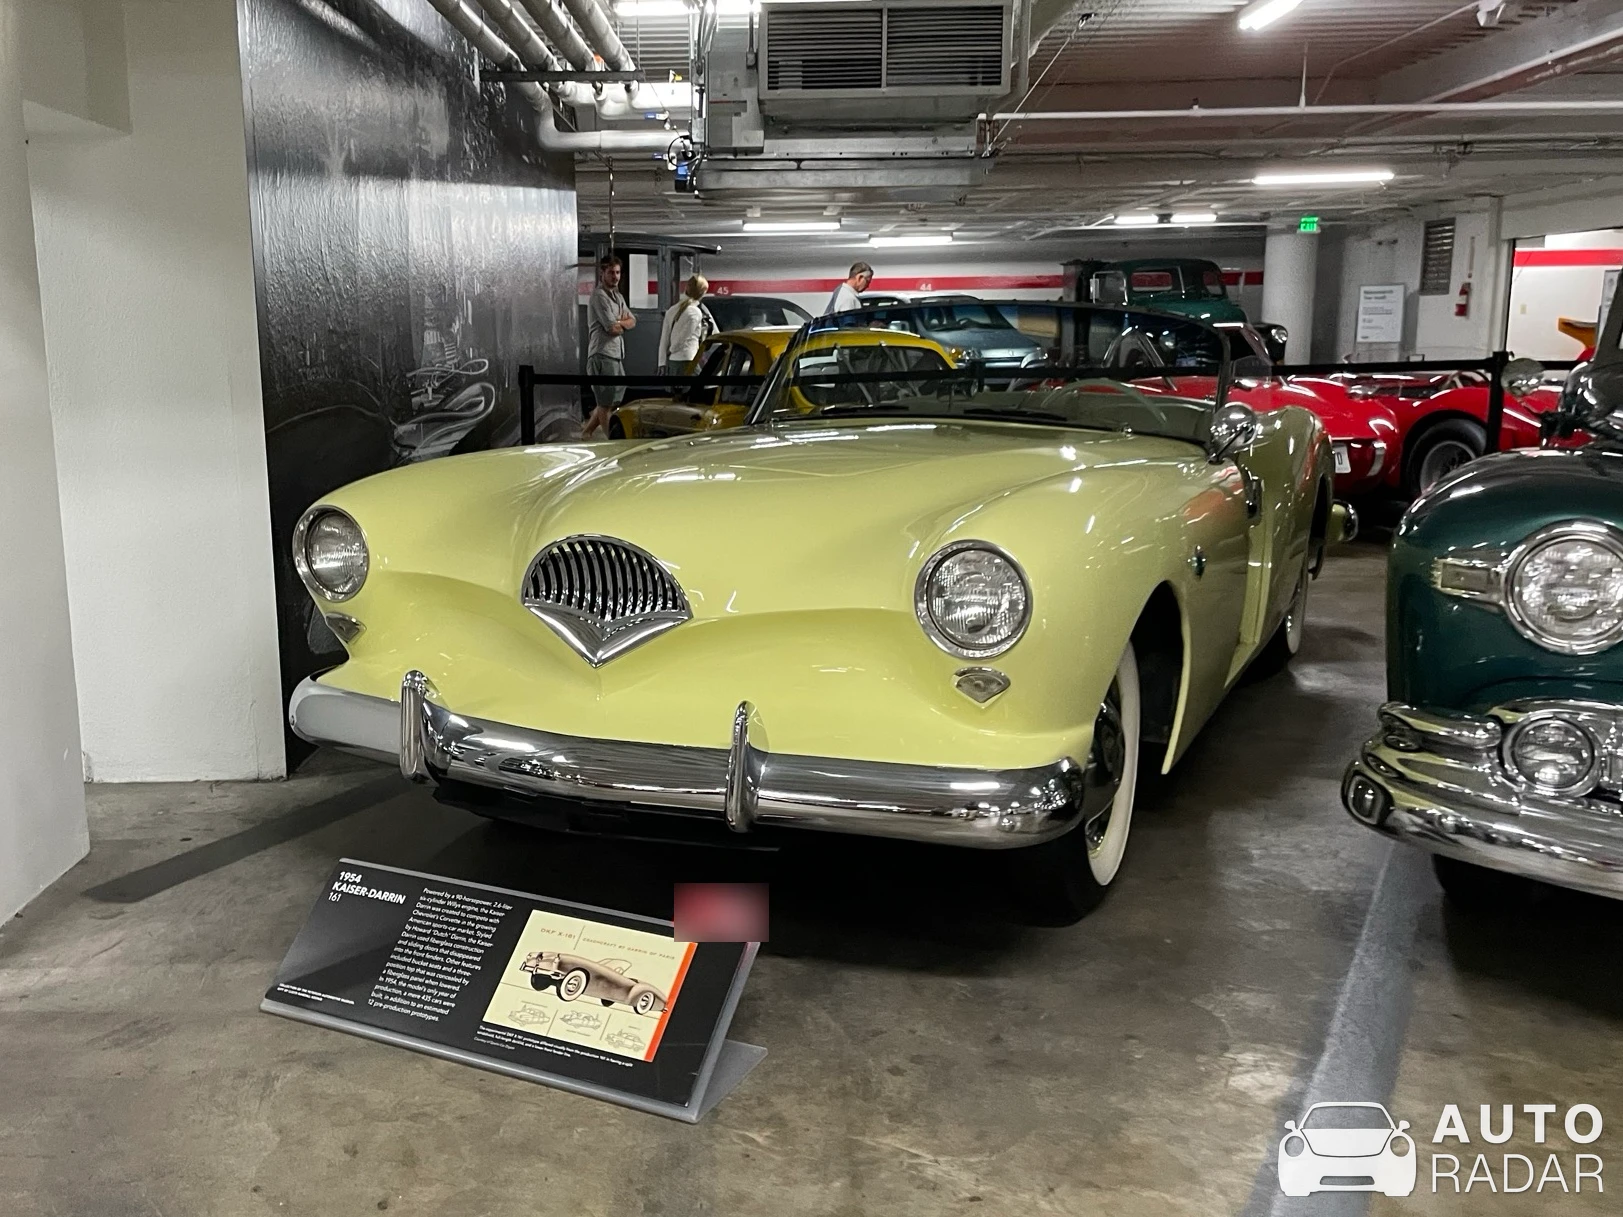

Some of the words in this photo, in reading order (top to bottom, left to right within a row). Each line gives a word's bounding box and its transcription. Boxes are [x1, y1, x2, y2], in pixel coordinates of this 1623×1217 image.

[716, 286, 729, 295] 45
[340, 871, 362, 884] 1954
[328, 892, 342, 902] 161
[332, 881, 406, 904] KAISER-DARRIN
[423, 888, 444, 896] Powered
[408, 917, 431, 925] American
[476, 931, 492, 939] Styled
[440, 915, 460, 924] Corvette
[476, 924, 496, 932] growing
[430, 937, 453, 947] fiberglass
[453, 944, 484, 953] construction
[408, 942, 424, 950] sliding
[450, 951, 481, 961] disappeared
[461, 961, 481, 970] features
[387, 969, 410, 979] fiberglass
[436, 974, 462, 983] concealed
[373, 1002, 411, 1014] pre-production
[389, 997, 410, 1005] addition
[424, 1005, 449, 1014] estimated
